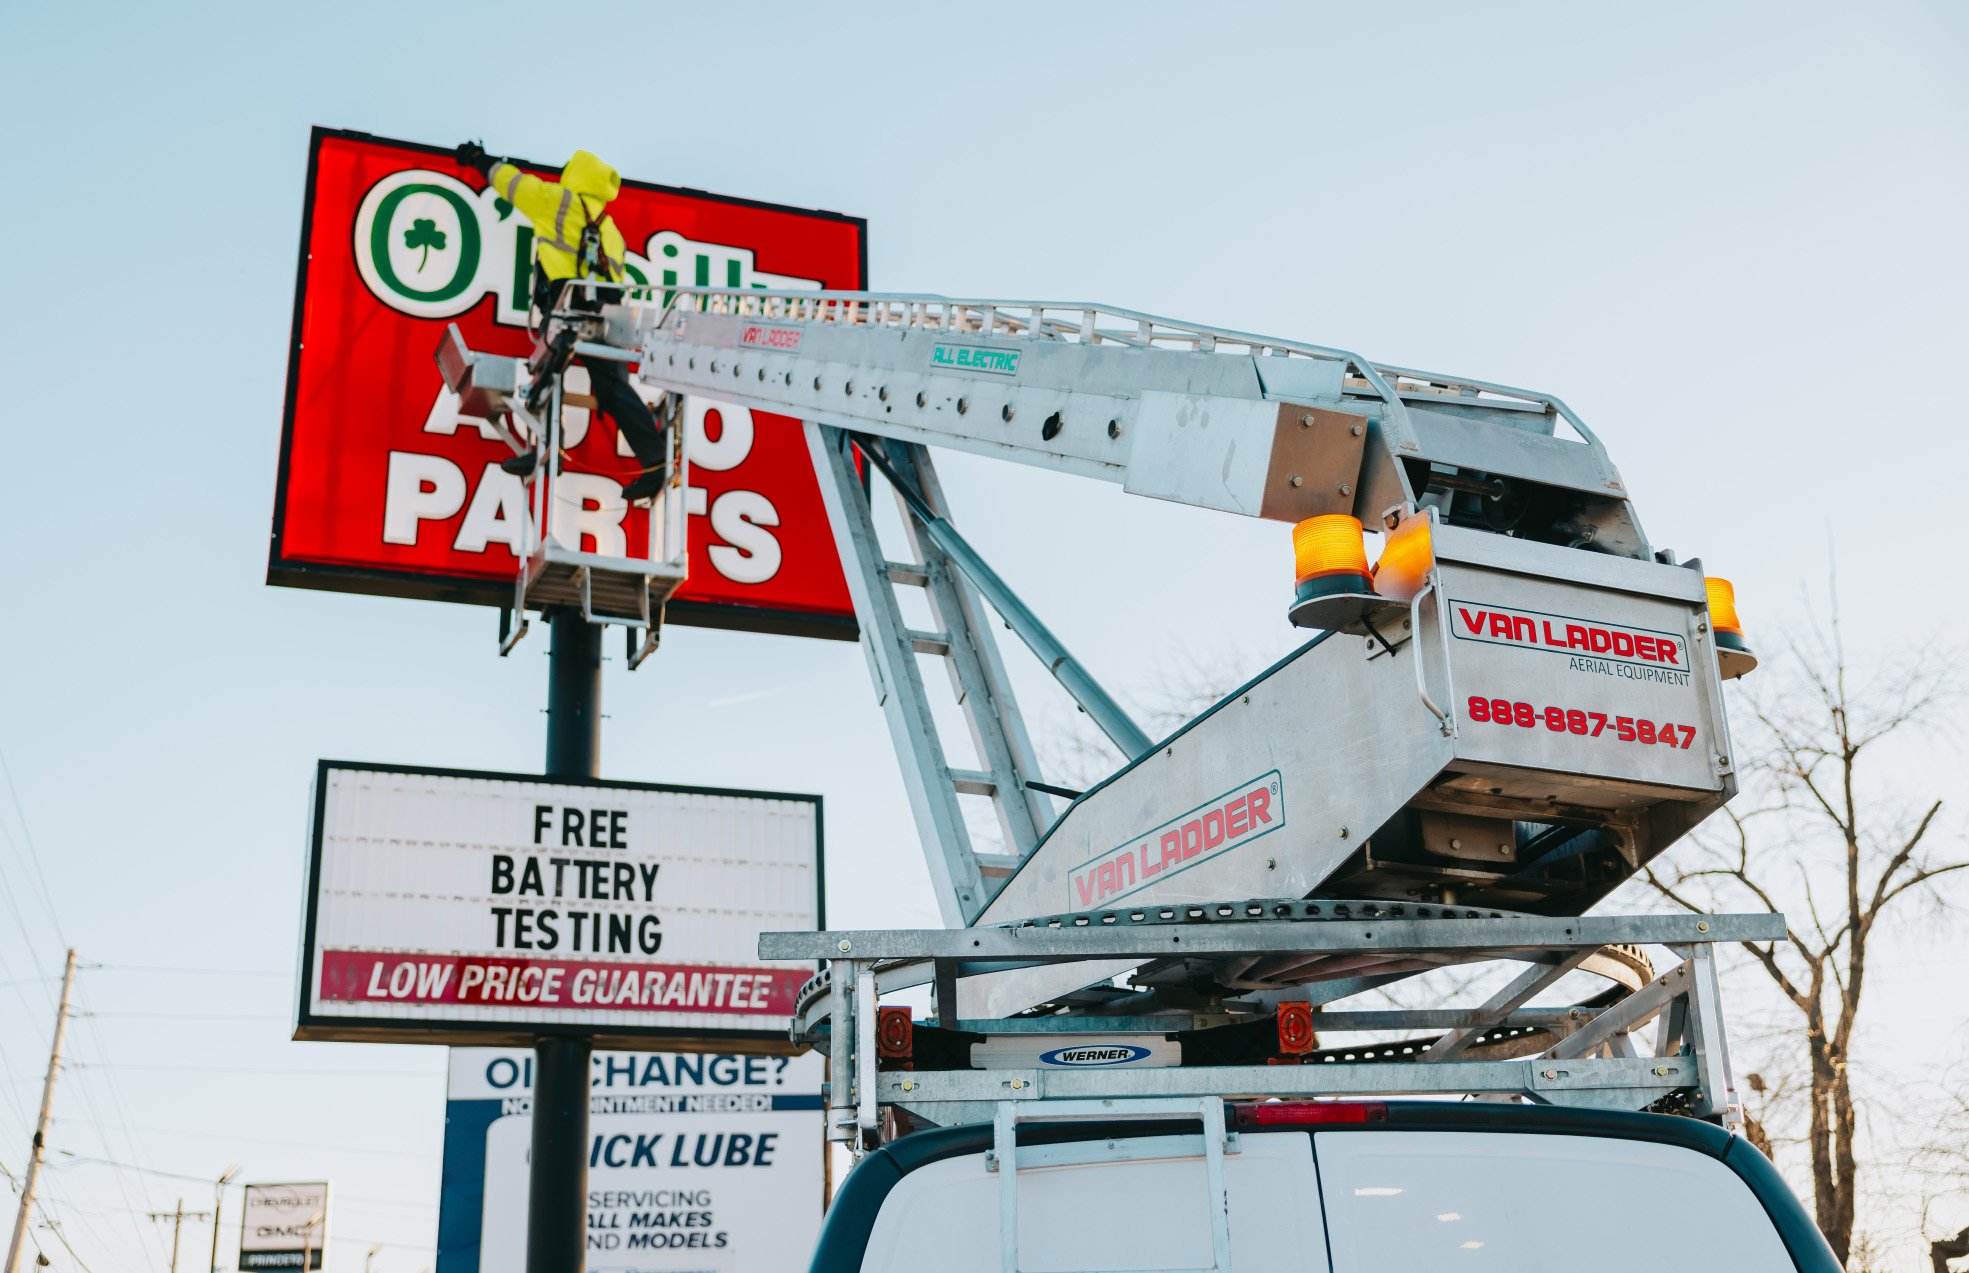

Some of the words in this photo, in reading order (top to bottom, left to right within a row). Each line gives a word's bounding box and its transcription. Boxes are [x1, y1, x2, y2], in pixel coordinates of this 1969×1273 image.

[933, 346, 955, 365] ALL
[956, 348, 1019, 372] ELECTRIC
[382, 450, 783, 585] PARTS
[1458, 607, 1538, 644] VAN
[1568, 656, 1614, 676] AERIAL
[1616, 663, 1691, 687] EQUIPMENT
[1467, 695, 1697, 750] 888-887-5847
[533, 804, 629, 850] FREE
[490, 854, 661, 902] BATTERY
[1074, 850, 1136, 907] VAN
[490, 906, 664, 956] TESTING
[366, 961, 454, 999] LOW
[457, 964, 566, 1002] PRICE
[571, 967, 773, 1010] GUARANTEE
[485, 1057, 532, 1089] OI
[1062, 1049, 1129, 1062] WERNER
[685, 1094, 773, 1113] NEEDED!
[669, 1132, 779, 1168] LUBE
[588, 1189, 712, 1209] SERVICING
[628, 1211, 713, 1229] MAKES
[587, 1233, 621, 1250] ND
[627, 1231, 729, 1249] MODELS
